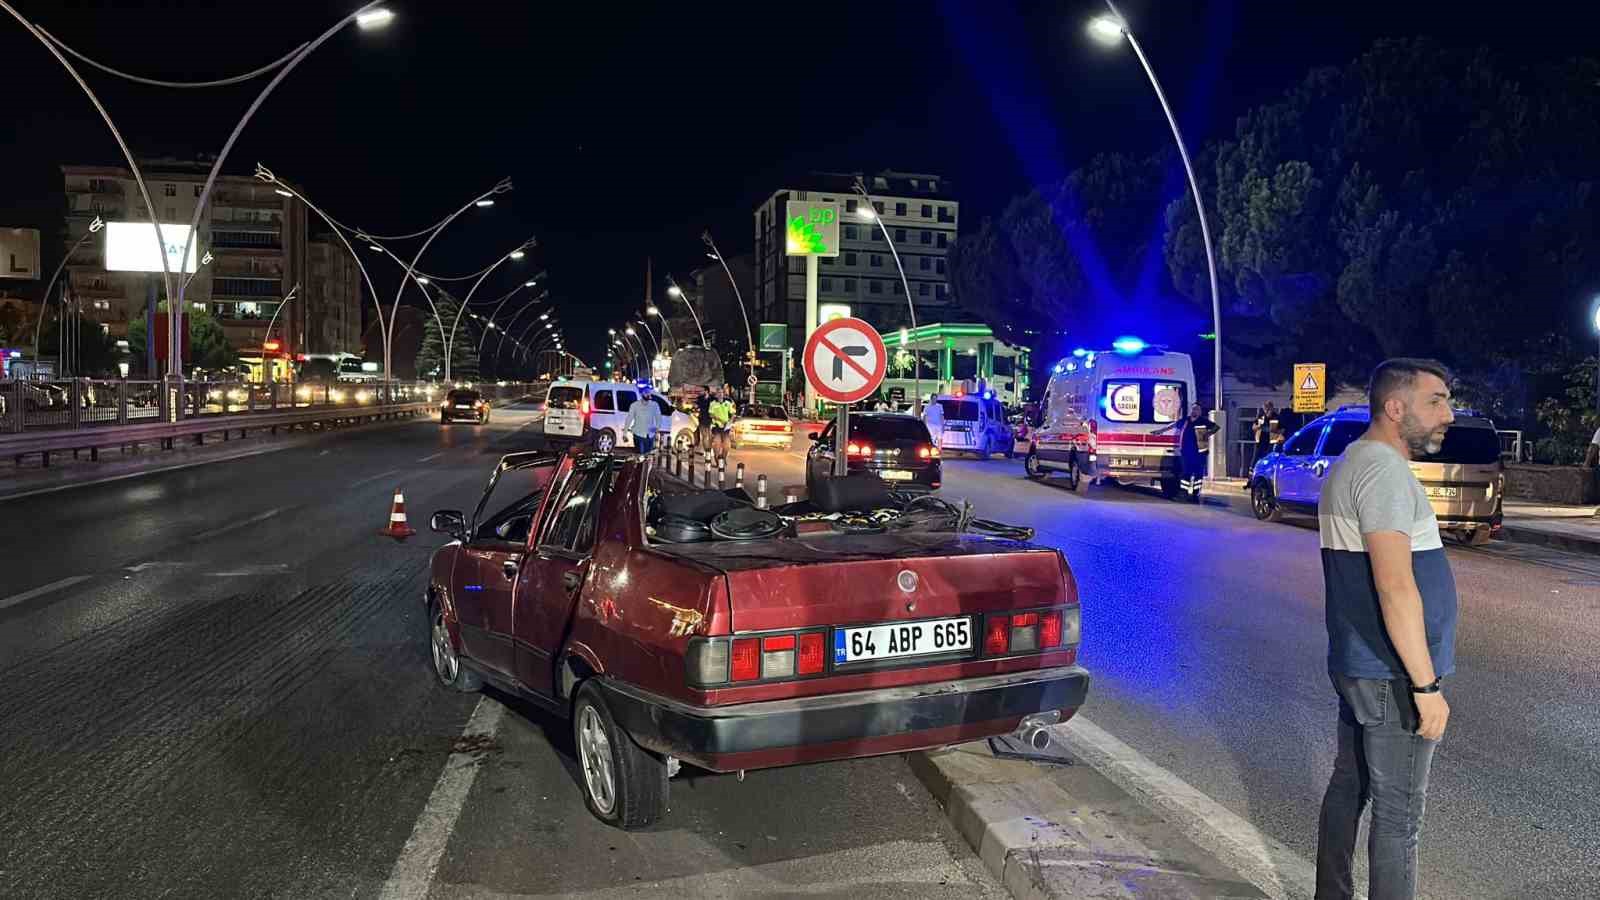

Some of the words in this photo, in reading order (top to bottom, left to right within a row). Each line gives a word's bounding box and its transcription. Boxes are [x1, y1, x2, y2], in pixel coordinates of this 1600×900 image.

[809, 208, 834, 224] bp
[852, 631, 876, 656] 64
[888, 627, 922, 653] ABP
[934, 621, 968, 648] 665
